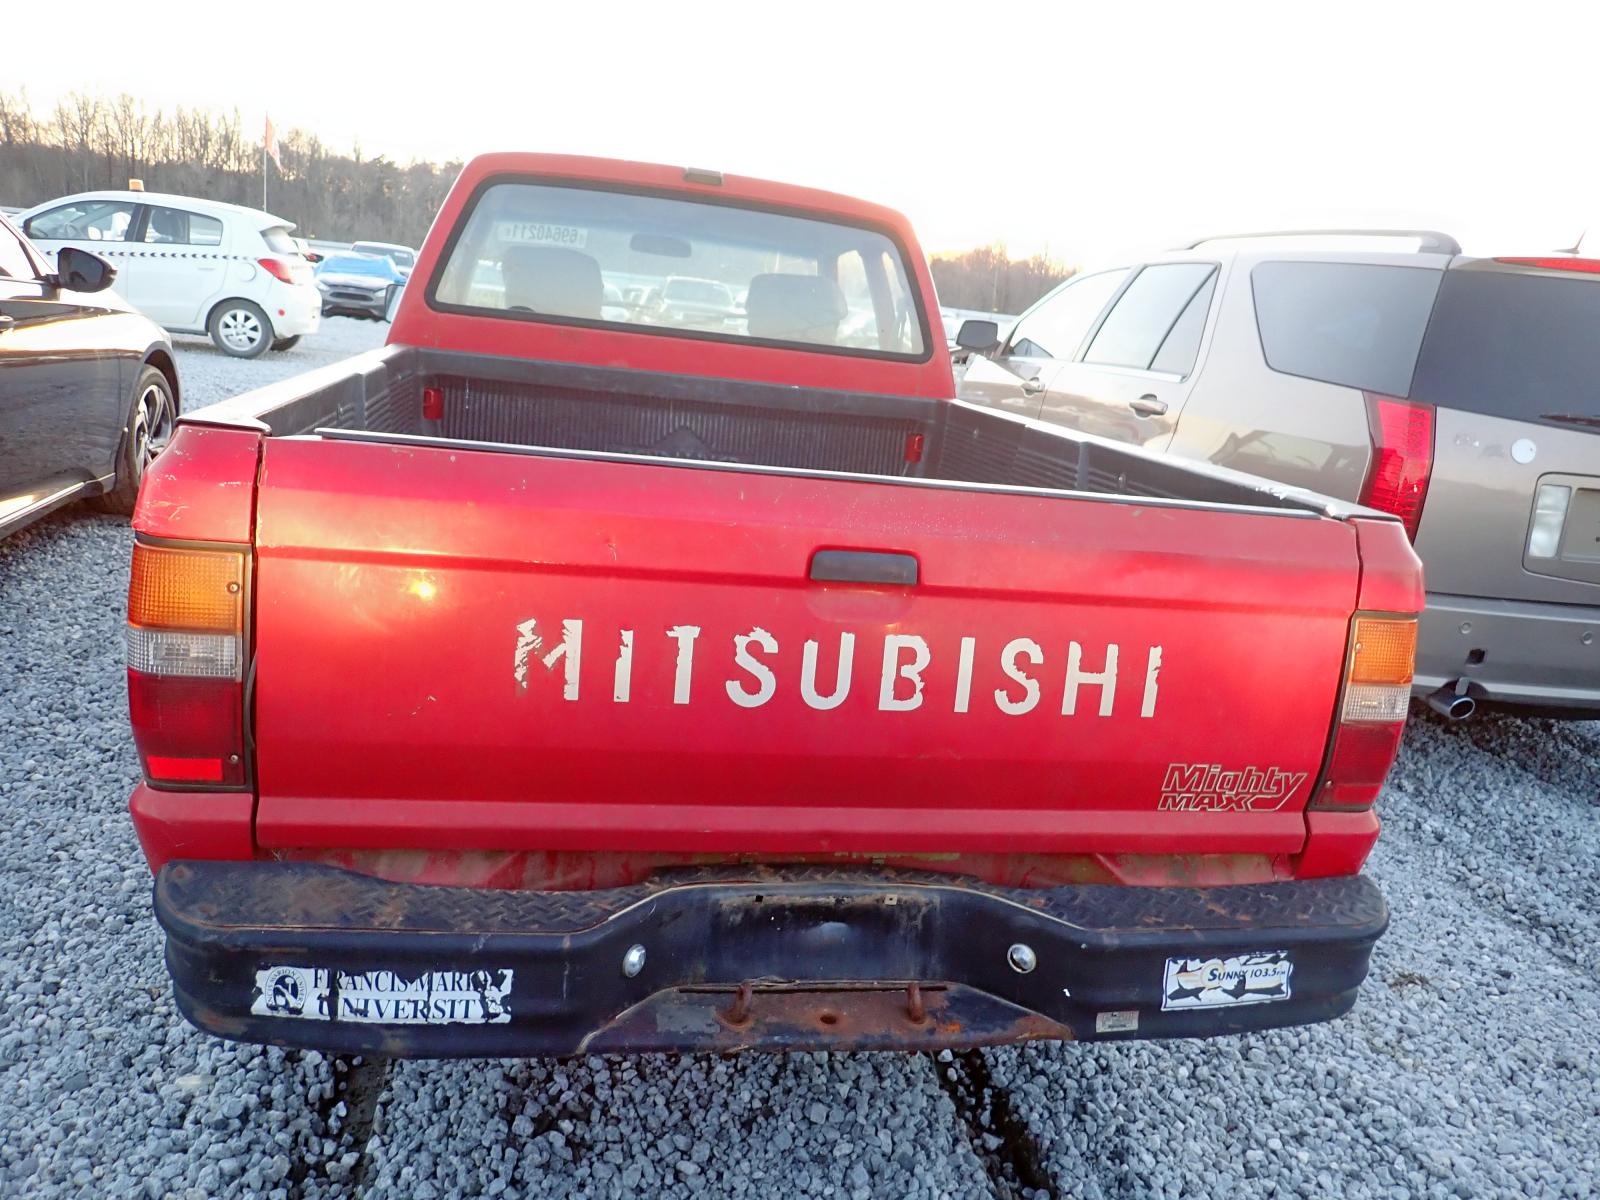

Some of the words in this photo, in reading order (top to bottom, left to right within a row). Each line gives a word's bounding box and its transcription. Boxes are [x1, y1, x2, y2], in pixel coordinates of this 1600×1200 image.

[514, 618, 1163, 718] MITSUBISHI
[1157, 793, 1246, 812] MAX
[1161, 763, 1308, 812] Mighty
